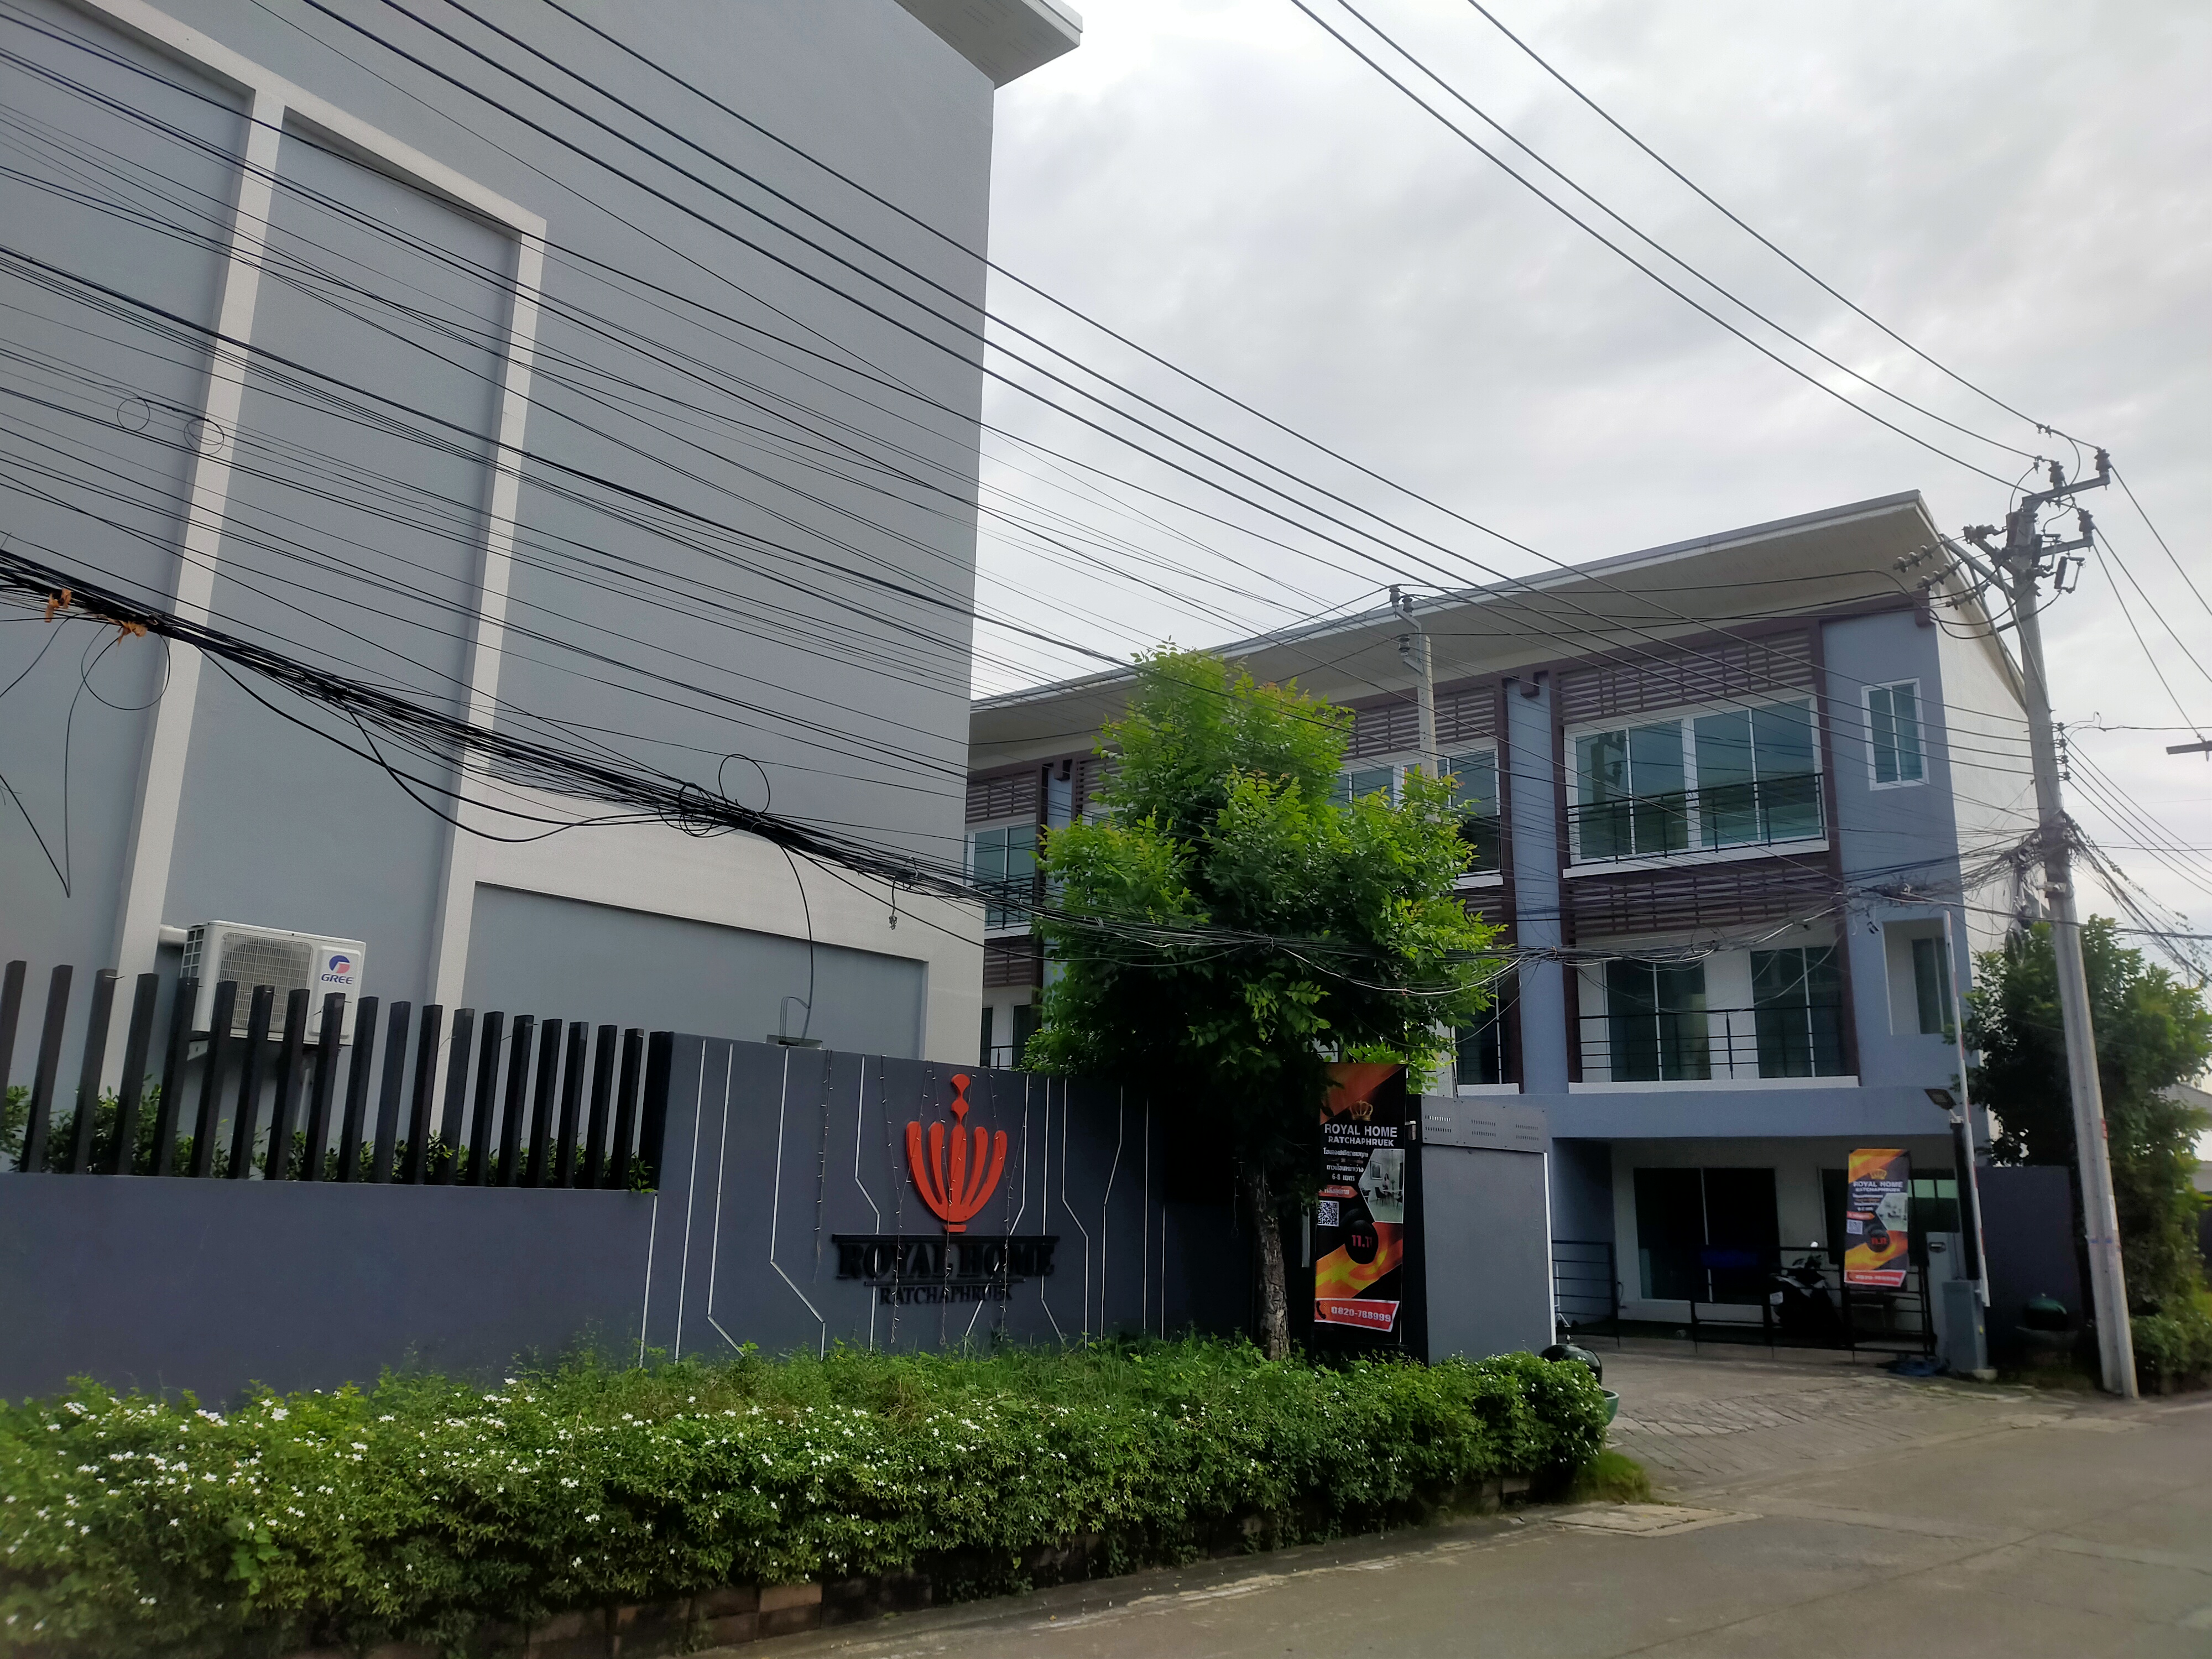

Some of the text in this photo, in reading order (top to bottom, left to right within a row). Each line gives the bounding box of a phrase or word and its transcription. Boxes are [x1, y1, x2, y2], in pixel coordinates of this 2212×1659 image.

[321, 974, 354, 984] GREE
[1324, 1124, 1397, 1138] ROYAL HOME
[1328, 1136, 1394, 1147] RATCHAPHRUEK
[837, 1243, 1055, 1279] ROYAL HOME
[880, 1285, 1012, 1305] RATCHAPHRUEK
[1331, 1306, 1391, 1322] 0820-788999
